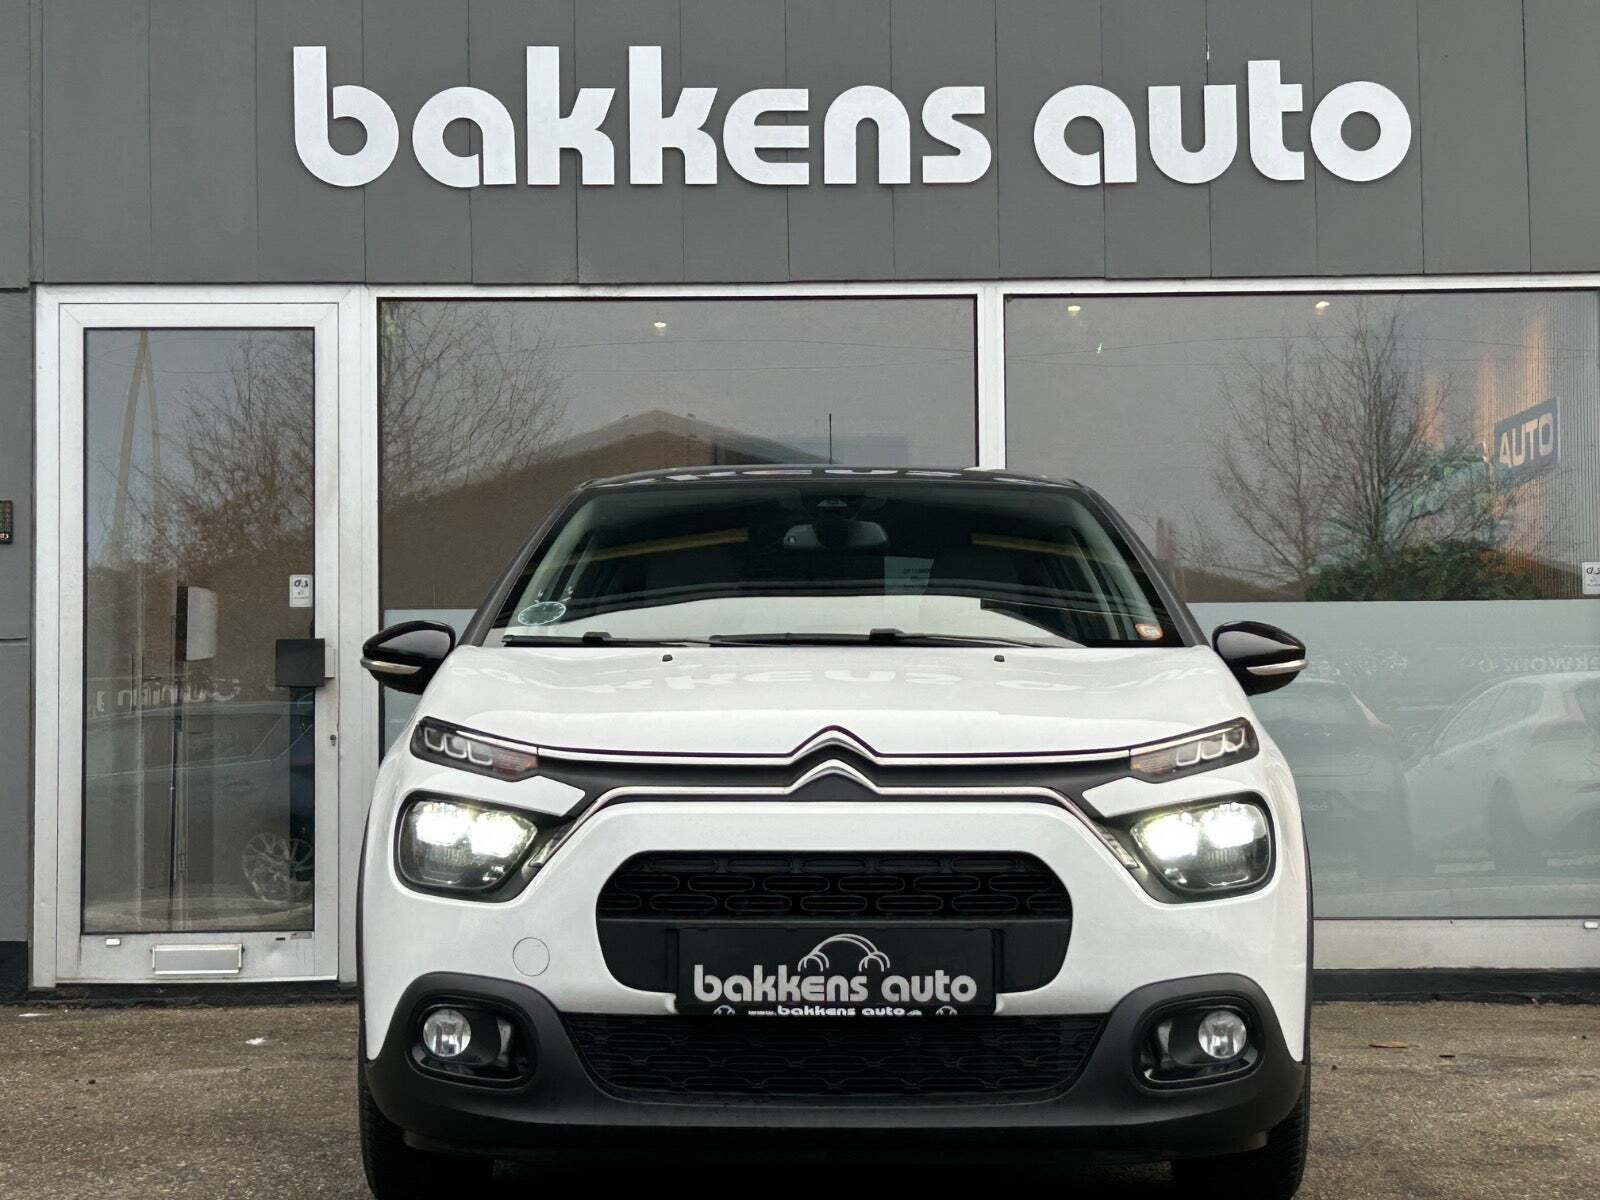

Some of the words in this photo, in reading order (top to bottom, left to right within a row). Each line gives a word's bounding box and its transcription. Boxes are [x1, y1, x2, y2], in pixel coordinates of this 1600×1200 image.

[293, 45, 992, 188] bakkens
[1033, 60, 1412, 186] auto
[1499, 412, 1554, 469] AUTO
[693, 964, 869, 1003] bakkens
[881, 969, 978, 1003] auto
